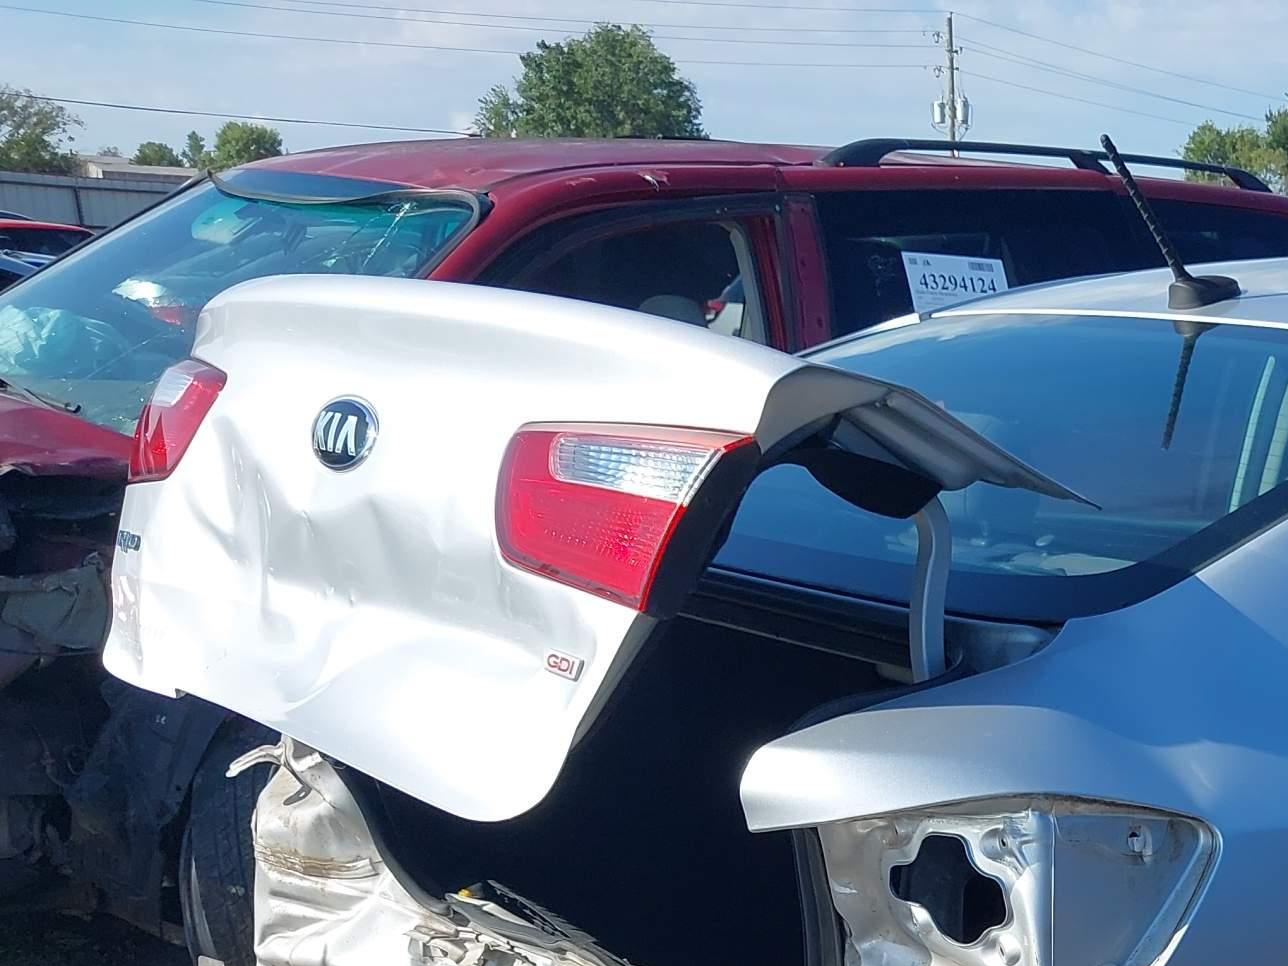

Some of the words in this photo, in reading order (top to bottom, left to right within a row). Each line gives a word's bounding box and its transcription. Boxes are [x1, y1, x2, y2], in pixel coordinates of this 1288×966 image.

[919, 272, 998, 294] 43294124
[313, 410, 358, 457] KIA
[547, 653, 575, 675] GDI
